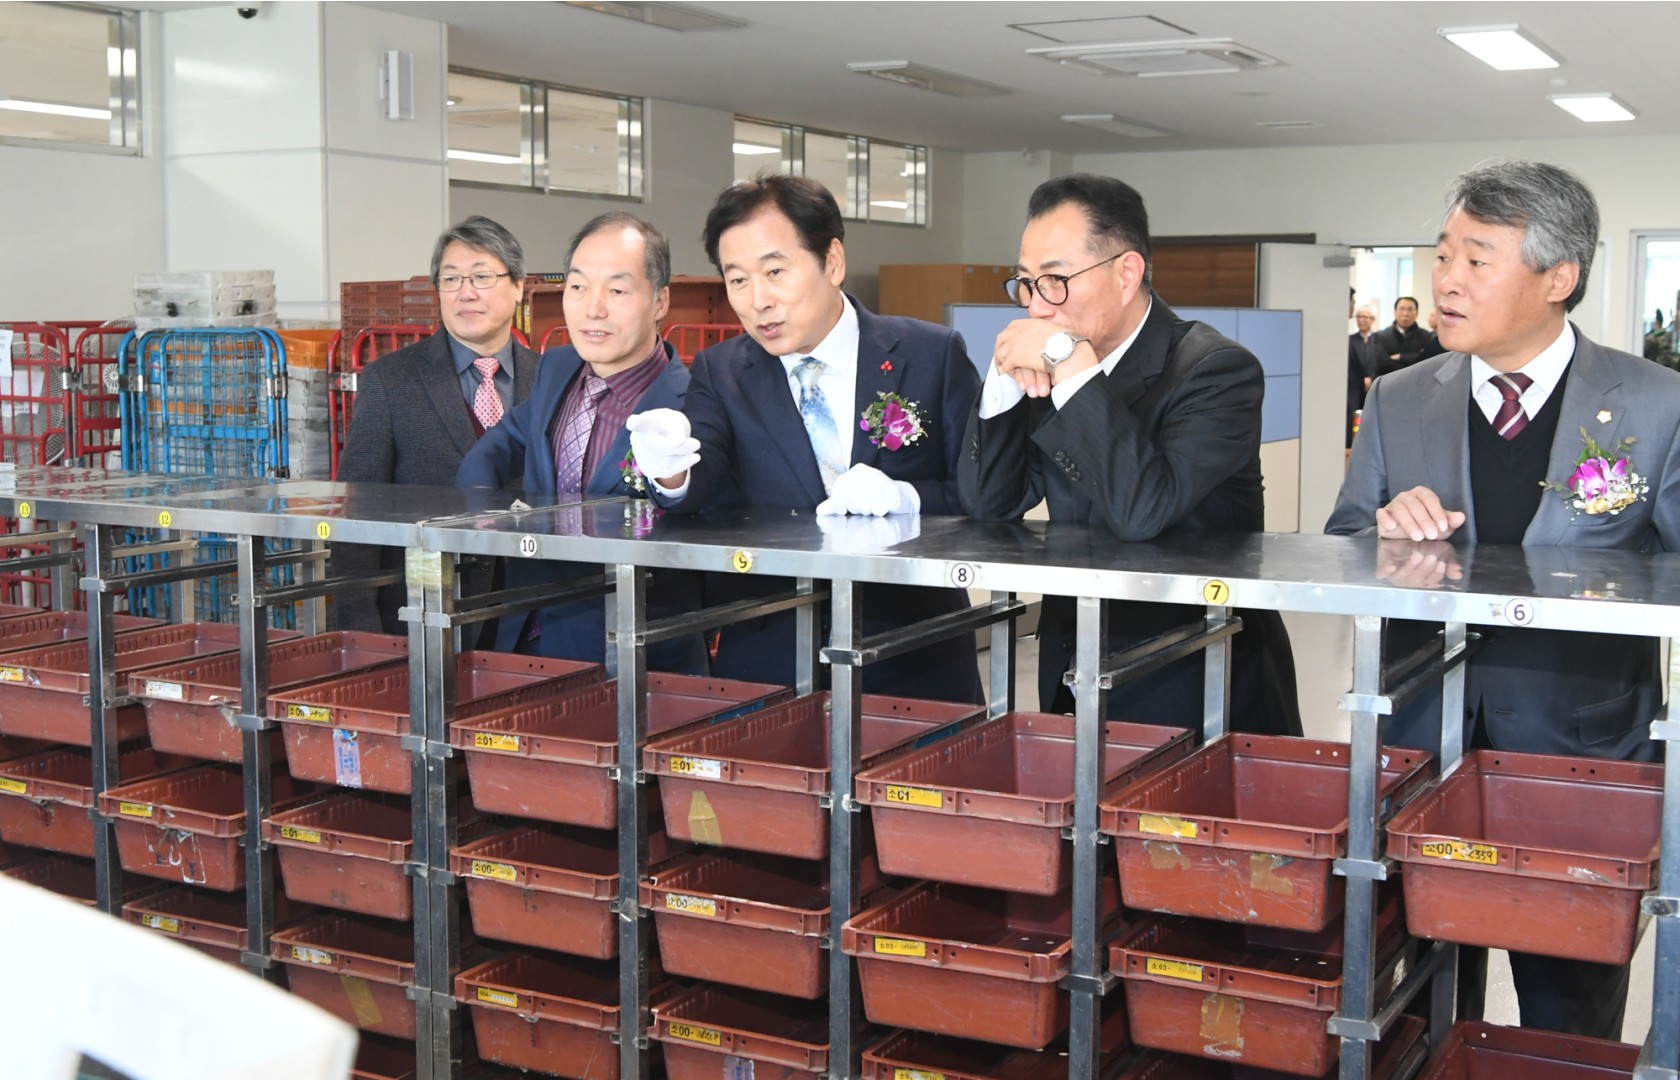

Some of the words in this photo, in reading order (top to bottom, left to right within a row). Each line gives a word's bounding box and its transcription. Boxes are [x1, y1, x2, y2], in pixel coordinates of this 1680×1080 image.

[21, 503, 29, 515] 13
[161, 514, 169, 524] 12
[320, 525, 328, 536] 11
[523, 539, 535, 553] 10
[958, 567, 968, 583] 8
[1211, 584, 1222, 601] 7
[1513, 603, 1526, 621] 6
